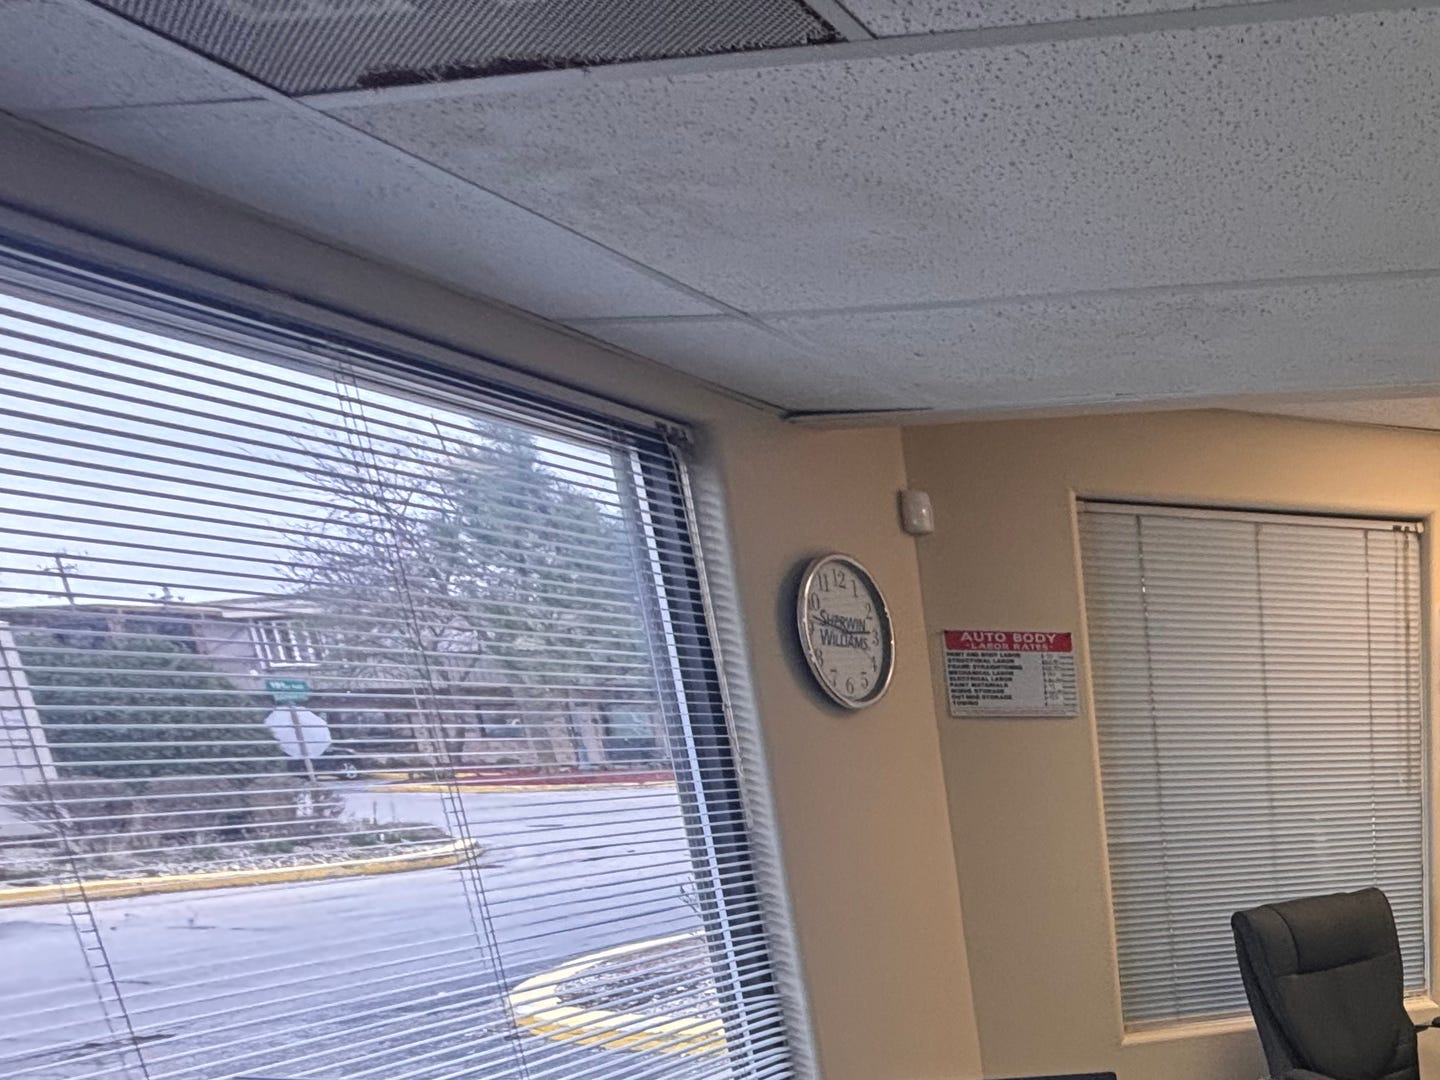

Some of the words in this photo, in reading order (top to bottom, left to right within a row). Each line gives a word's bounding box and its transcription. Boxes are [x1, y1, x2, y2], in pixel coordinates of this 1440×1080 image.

[832, 569, 846, 589] 12
[852, 580, 859, 598] 1
[866, 602, 873, 620] 2
[820, 609, 866, 632] SHERWIN
[820, 628, 869, 651] WILLIAMS
[872, 629, 880, 647] 3
[960, 632, 1007, 643] AUTO
[1013, 632, 1057, 644] BODY
